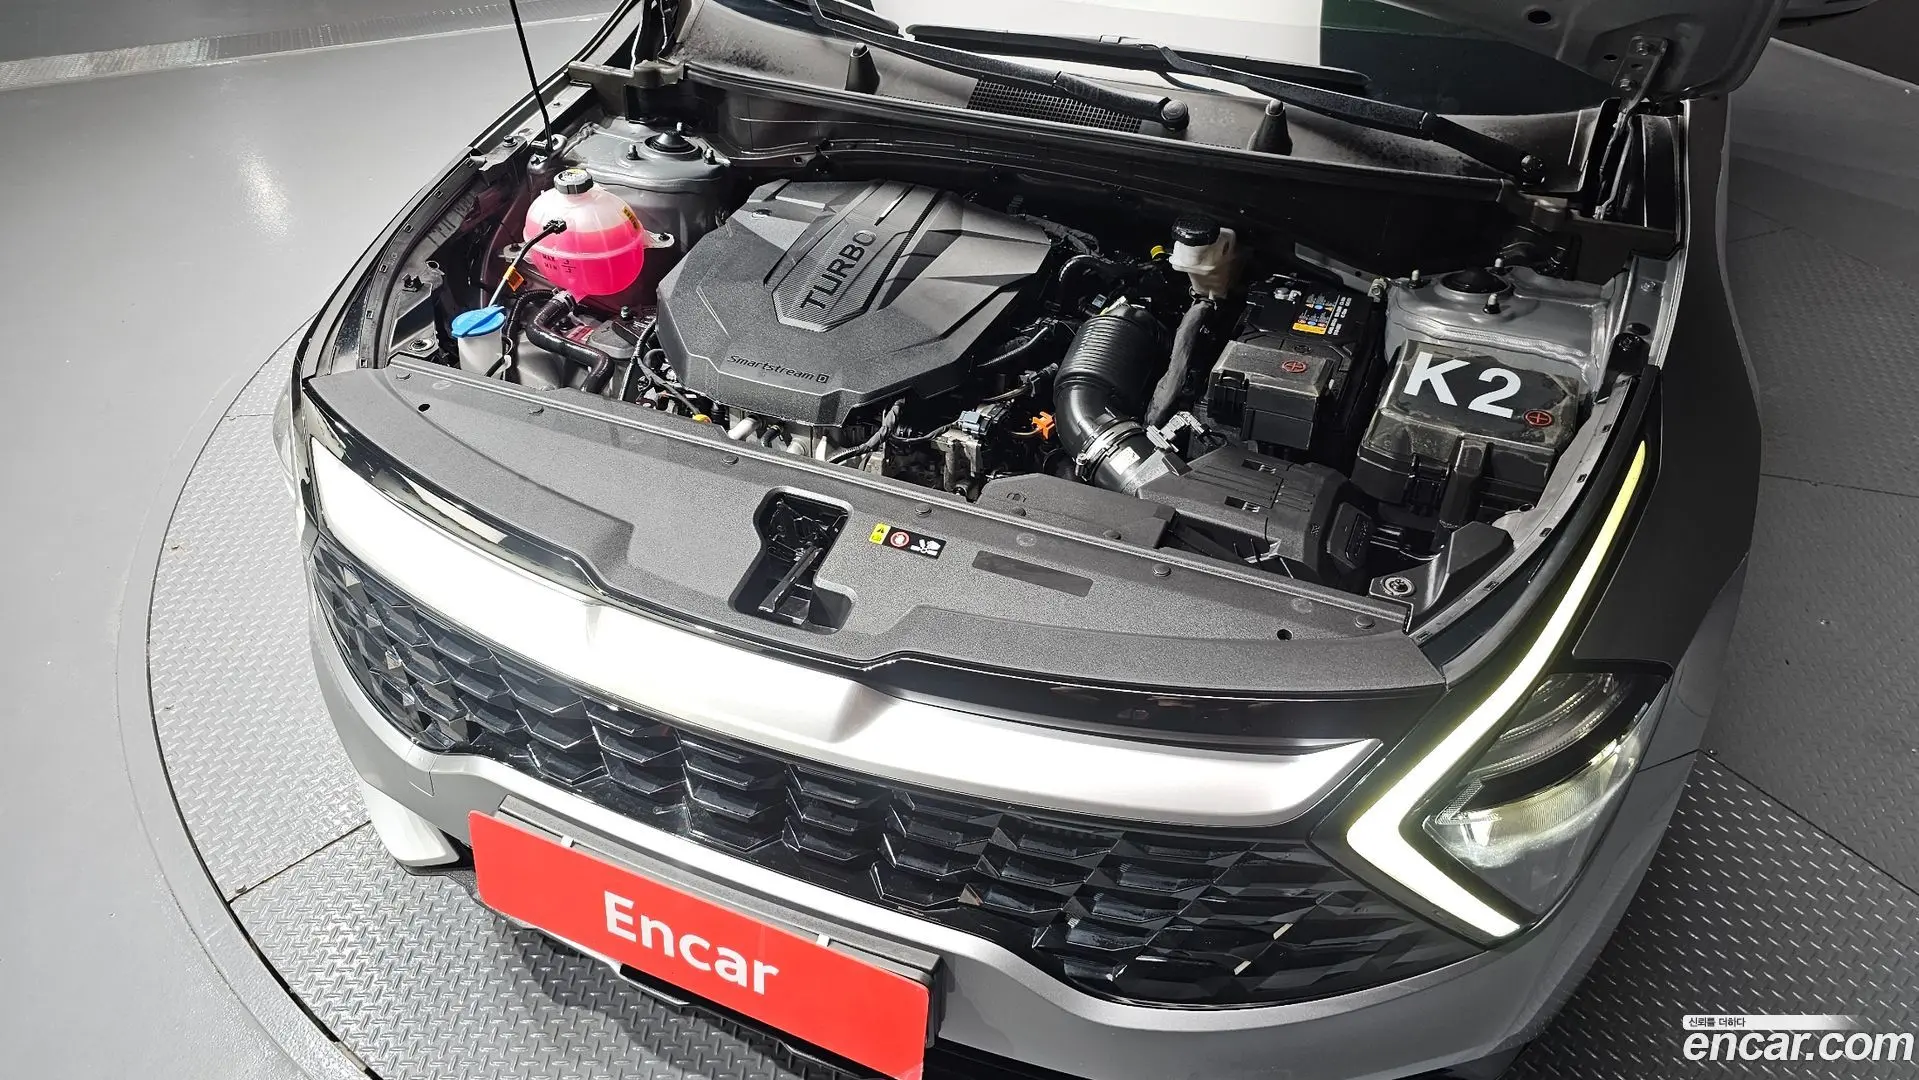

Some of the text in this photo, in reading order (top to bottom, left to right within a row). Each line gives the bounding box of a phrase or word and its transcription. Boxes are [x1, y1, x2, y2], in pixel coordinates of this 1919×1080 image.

[800, 230, 877, 309] TURBO
[727, 355, 815, 381] Smartstream
[603, 890, 779, 996] Encar
